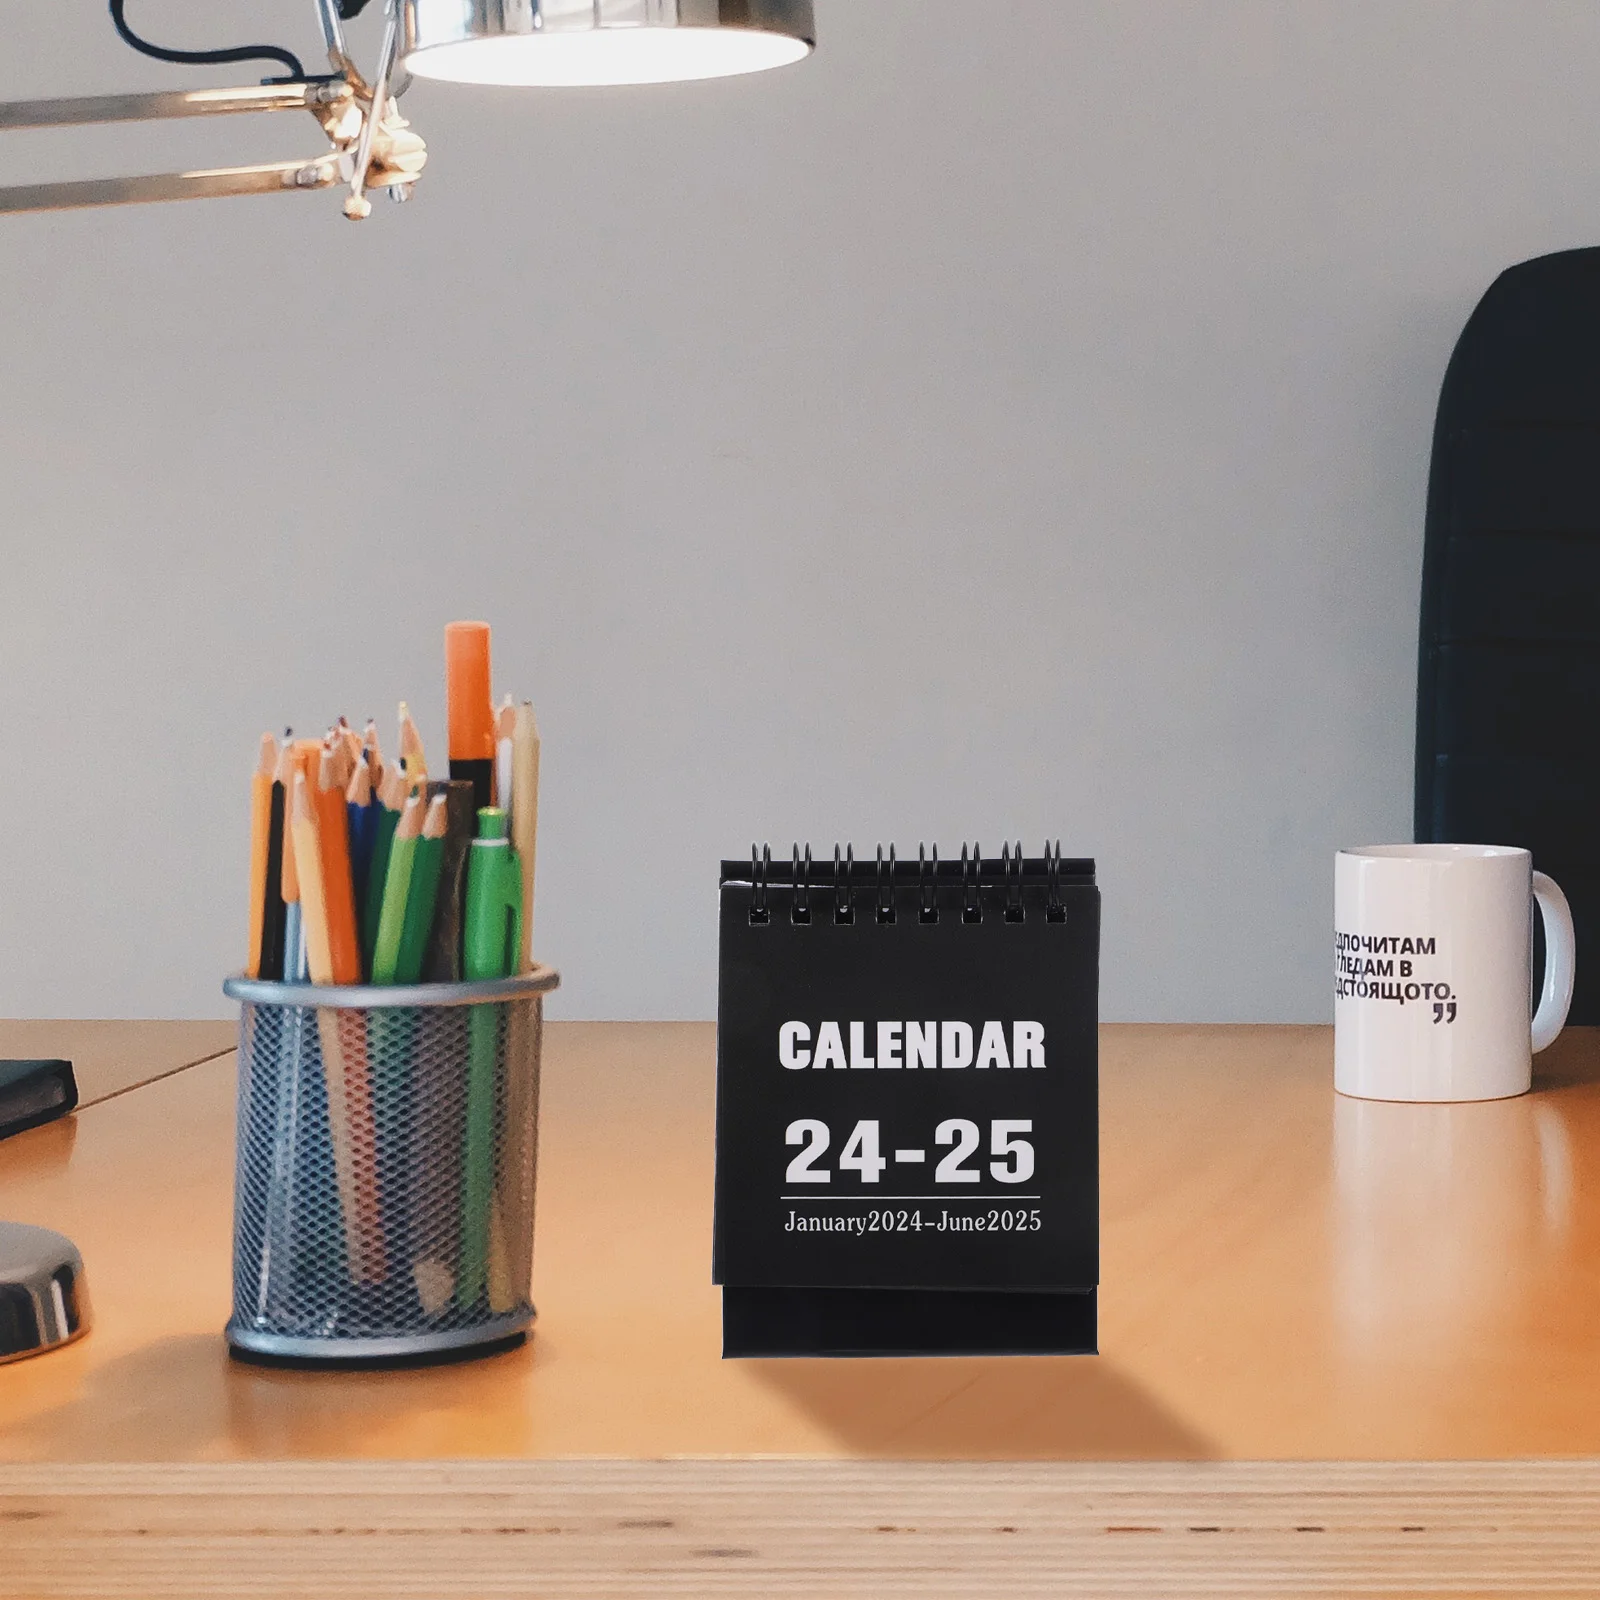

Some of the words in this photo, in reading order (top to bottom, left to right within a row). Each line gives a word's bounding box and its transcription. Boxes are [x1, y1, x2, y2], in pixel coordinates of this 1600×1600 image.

[1335, 932, 1436, 955] ДПОЧИТАМ
[1400, 959, 1413, 978] В
[1335, 977, 1457, 1006] ДСТОЯЩОТО.
[779, 1020, 1047, 1070] CALENDAR
[785, 1118, 1035, 1184] 24-25
[784, 1209, 1042, 1237] January2024-June2025
